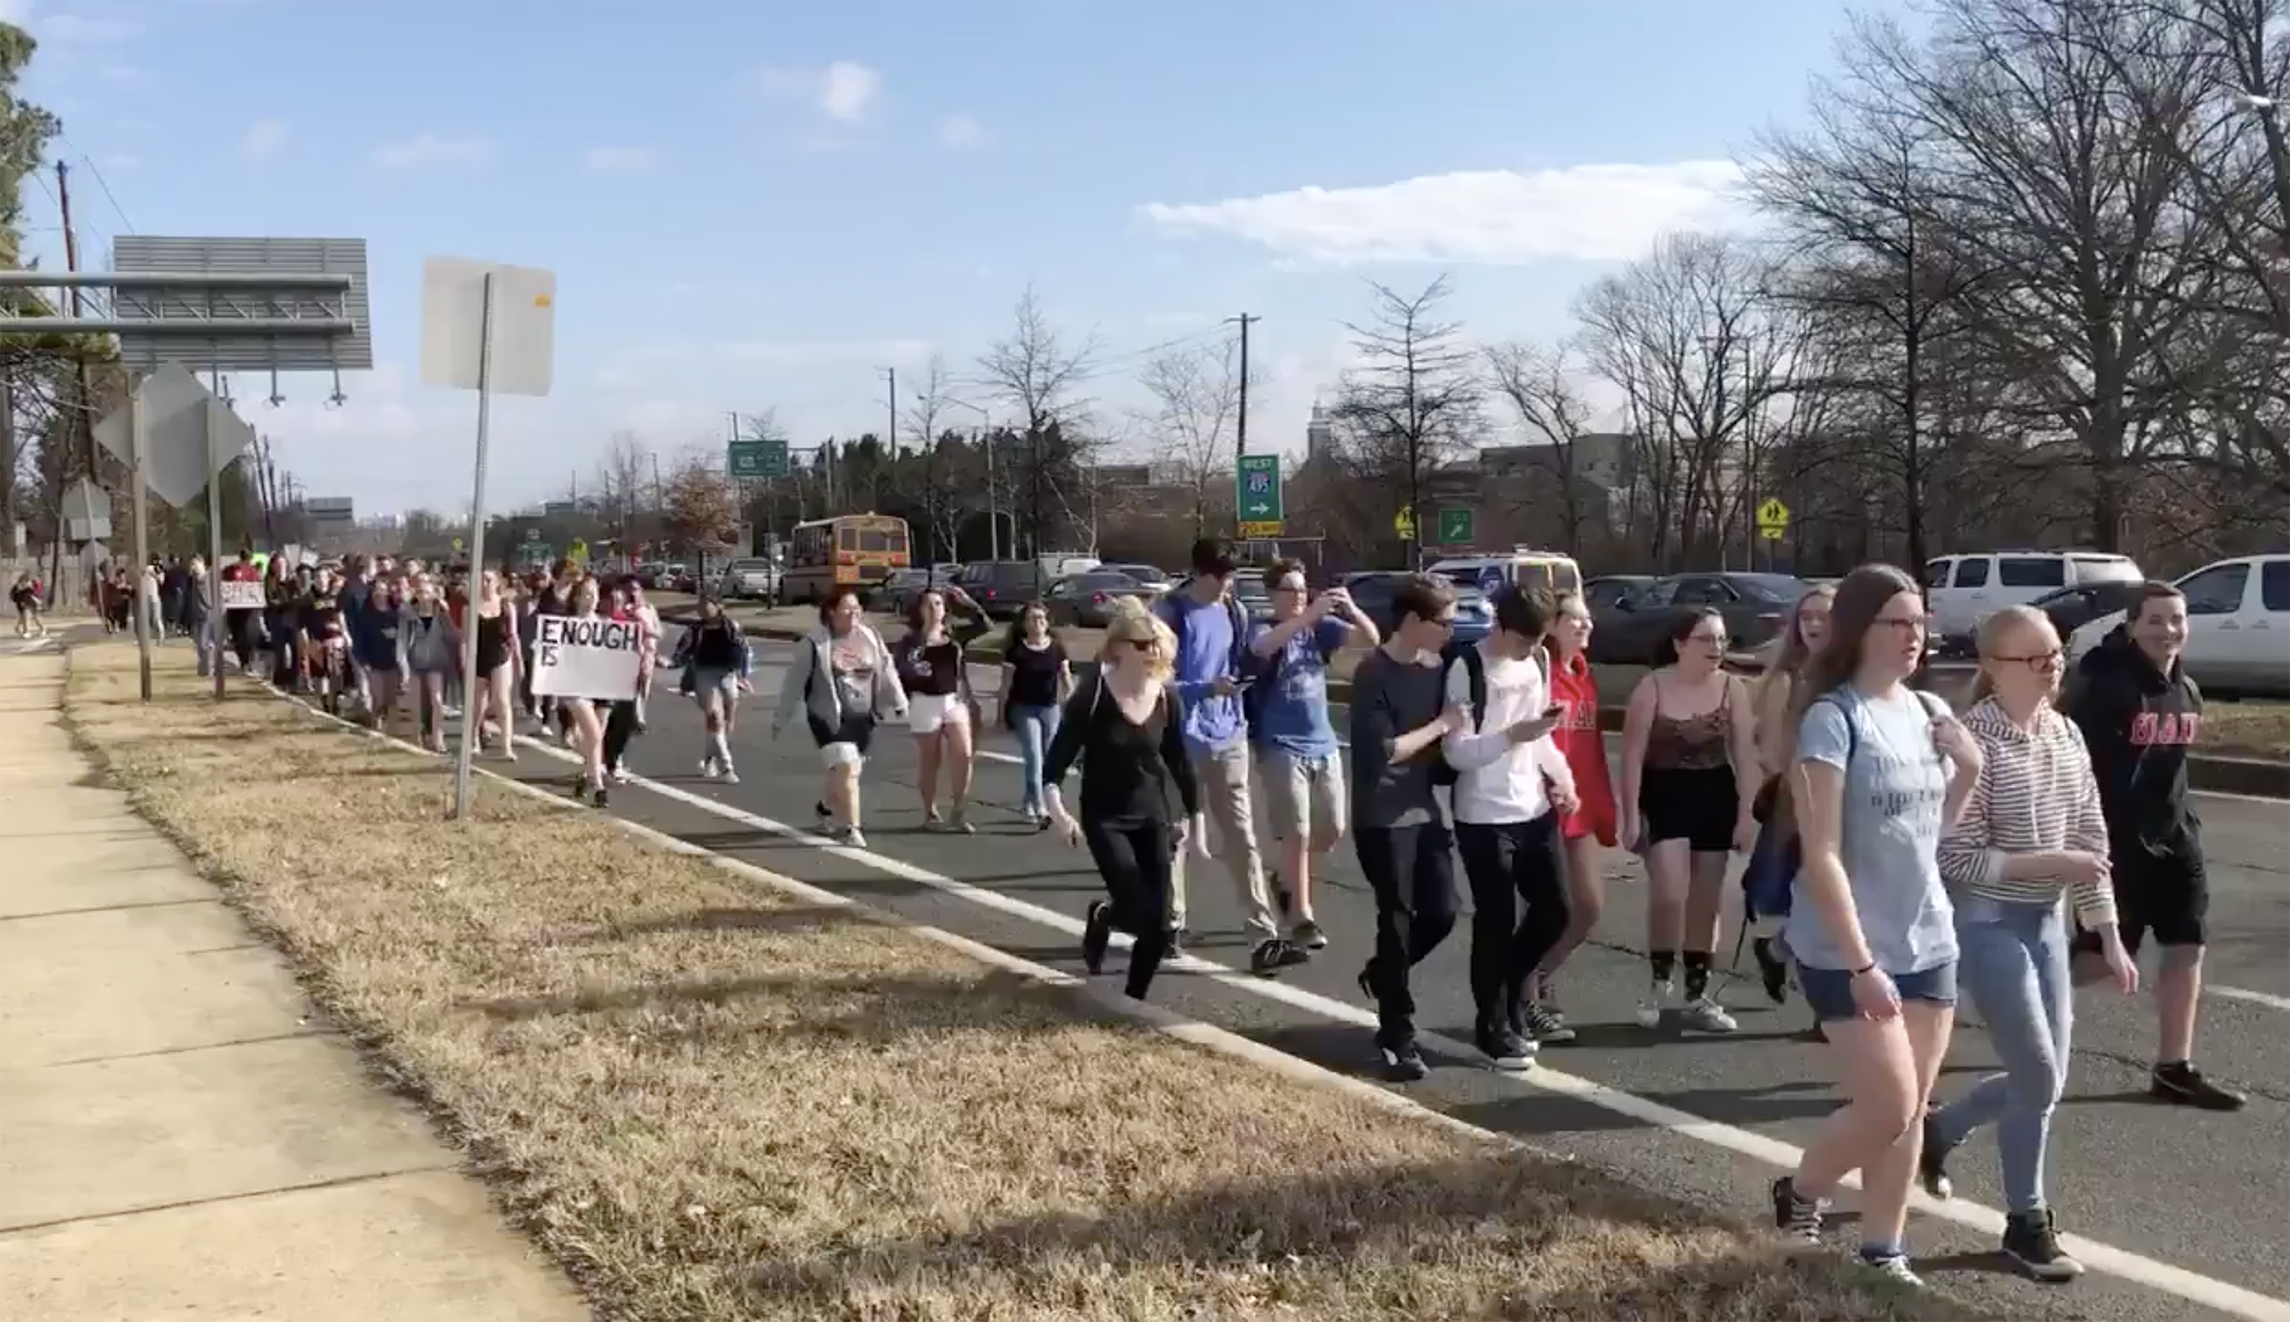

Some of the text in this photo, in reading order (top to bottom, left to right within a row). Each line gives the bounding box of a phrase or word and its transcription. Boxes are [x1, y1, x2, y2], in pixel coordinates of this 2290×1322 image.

[1242, 458, 1273, 469] WEST
[1248, 479, 1269, 493] 495
[542, 618, 639, 651] ENOUGH
[541, 645, 558, 667] IS
